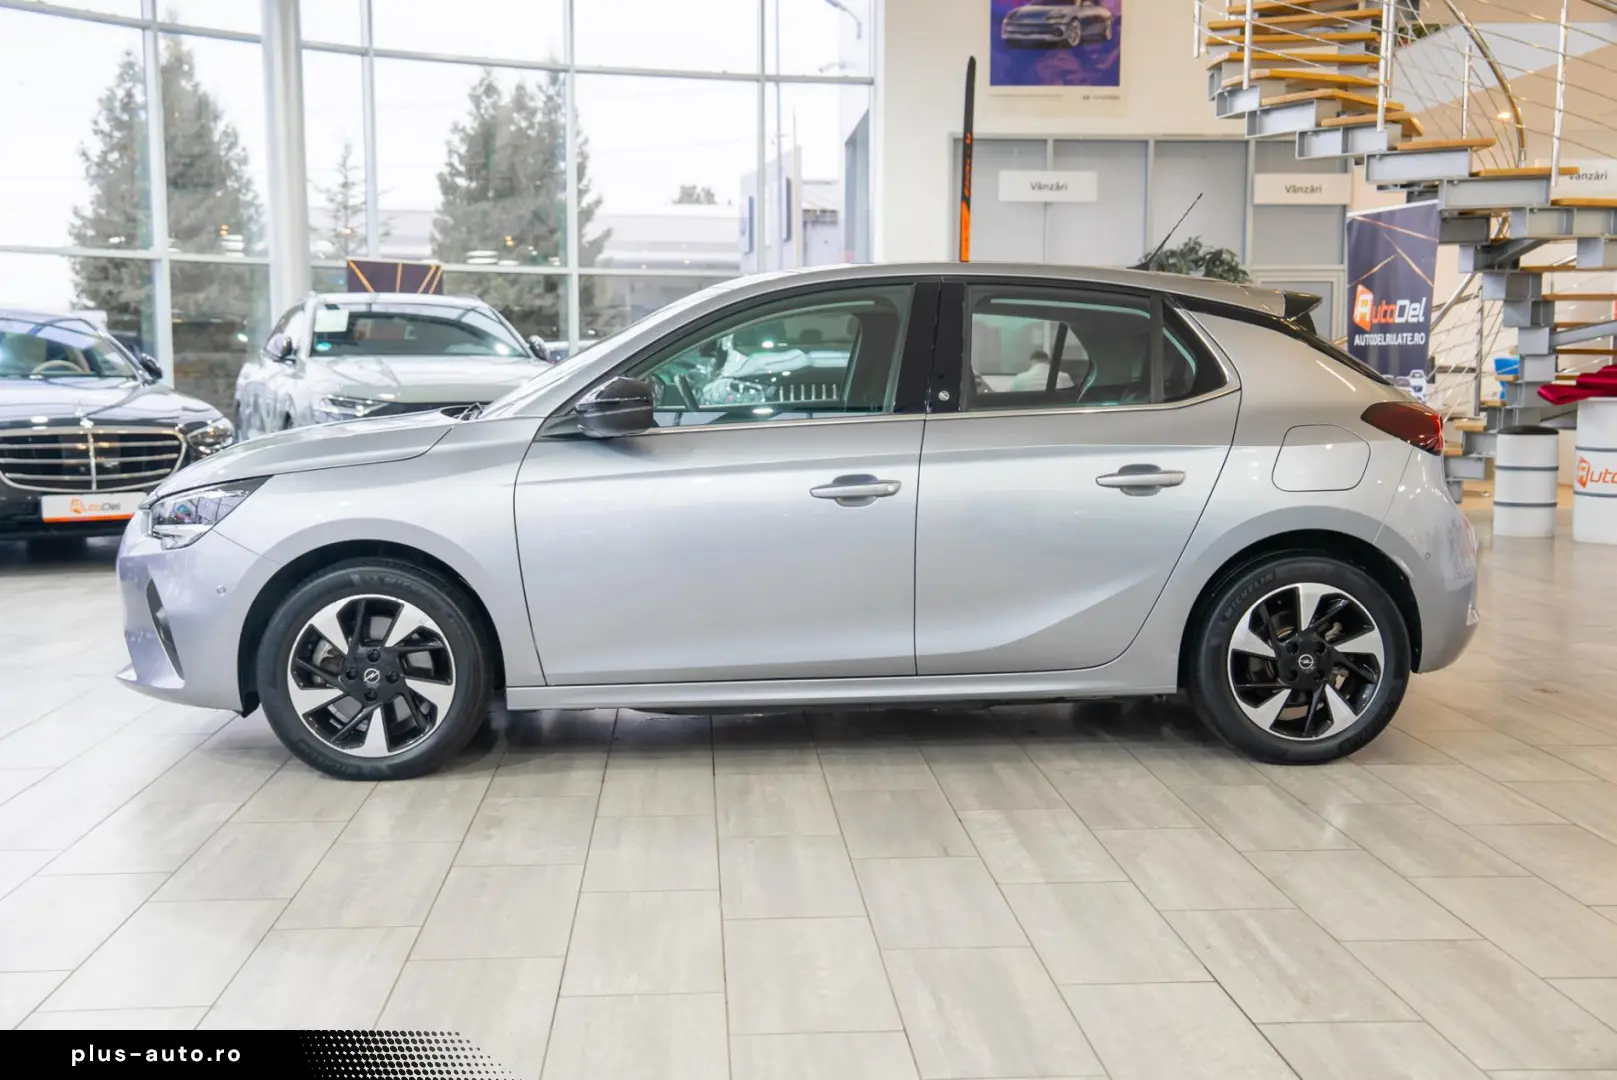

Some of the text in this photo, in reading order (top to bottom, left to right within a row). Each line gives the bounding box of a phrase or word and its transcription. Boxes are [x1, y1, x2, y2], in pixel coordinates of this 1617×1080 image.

[1029, 181, 1069, 192] Vânzări
[1284, 184, 1323, 194] Vânzări
[1353, 284, 1427, 332] AutoDel
[1353, 332, 1427, 347] AUTODELRULATE.RO
